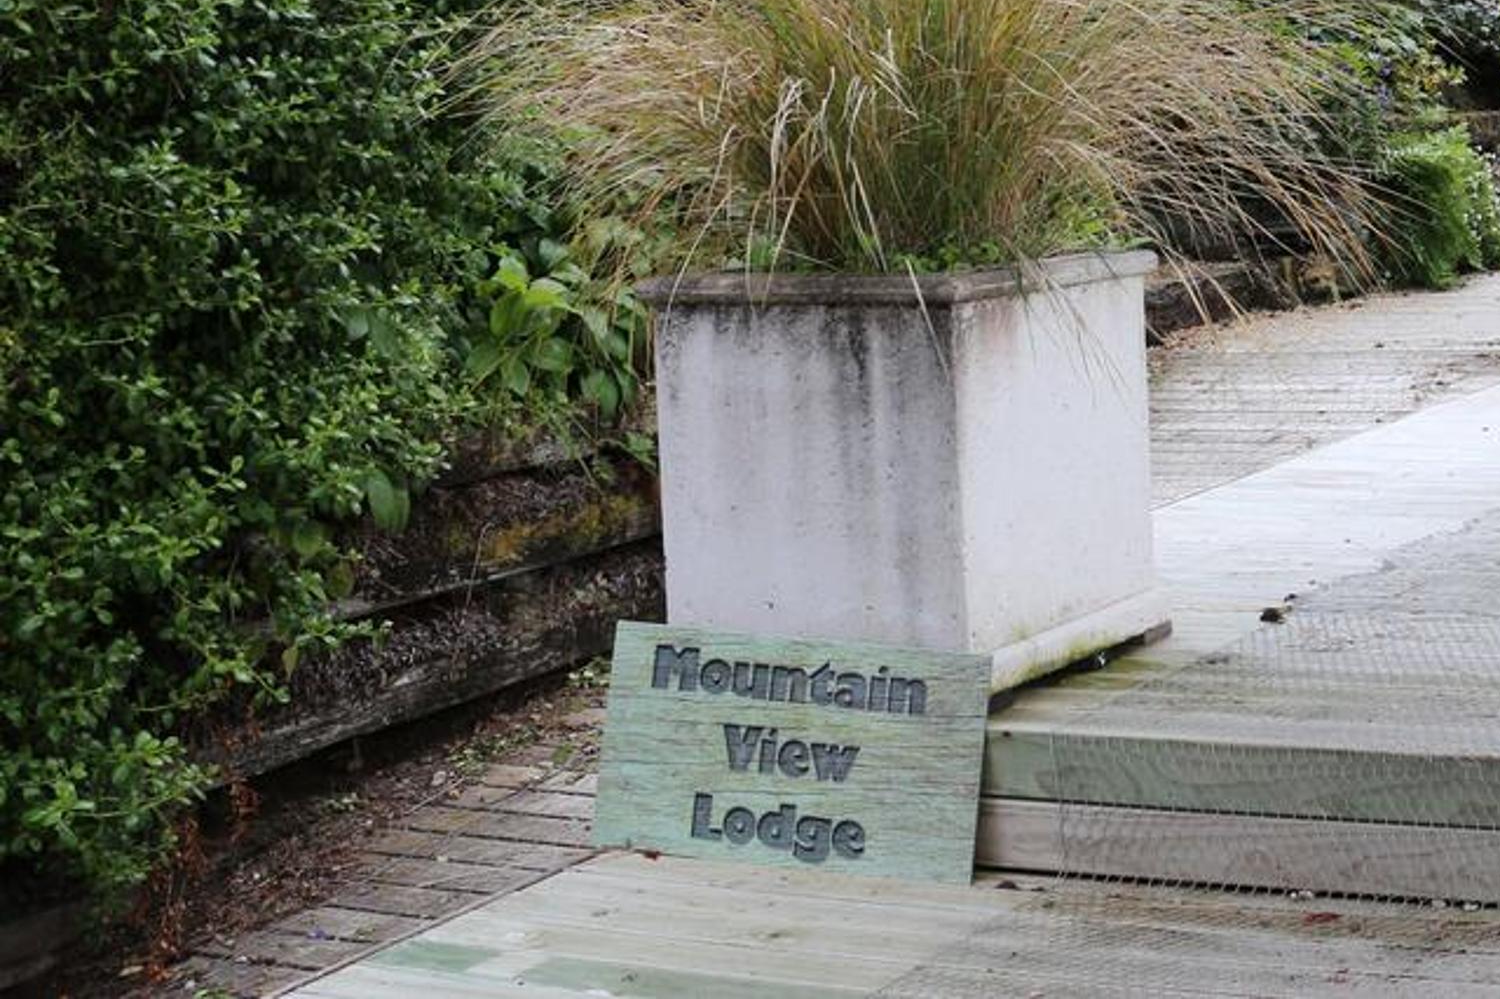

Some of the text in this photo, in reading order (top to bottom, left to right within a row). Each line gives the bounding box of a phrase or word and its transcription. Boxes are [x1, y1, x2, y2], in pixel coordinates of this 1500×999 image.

[651, 644, 928, 715] Mountain
[723, 723, 861, 783] View
[691, 792, 866, 864] Lodge
